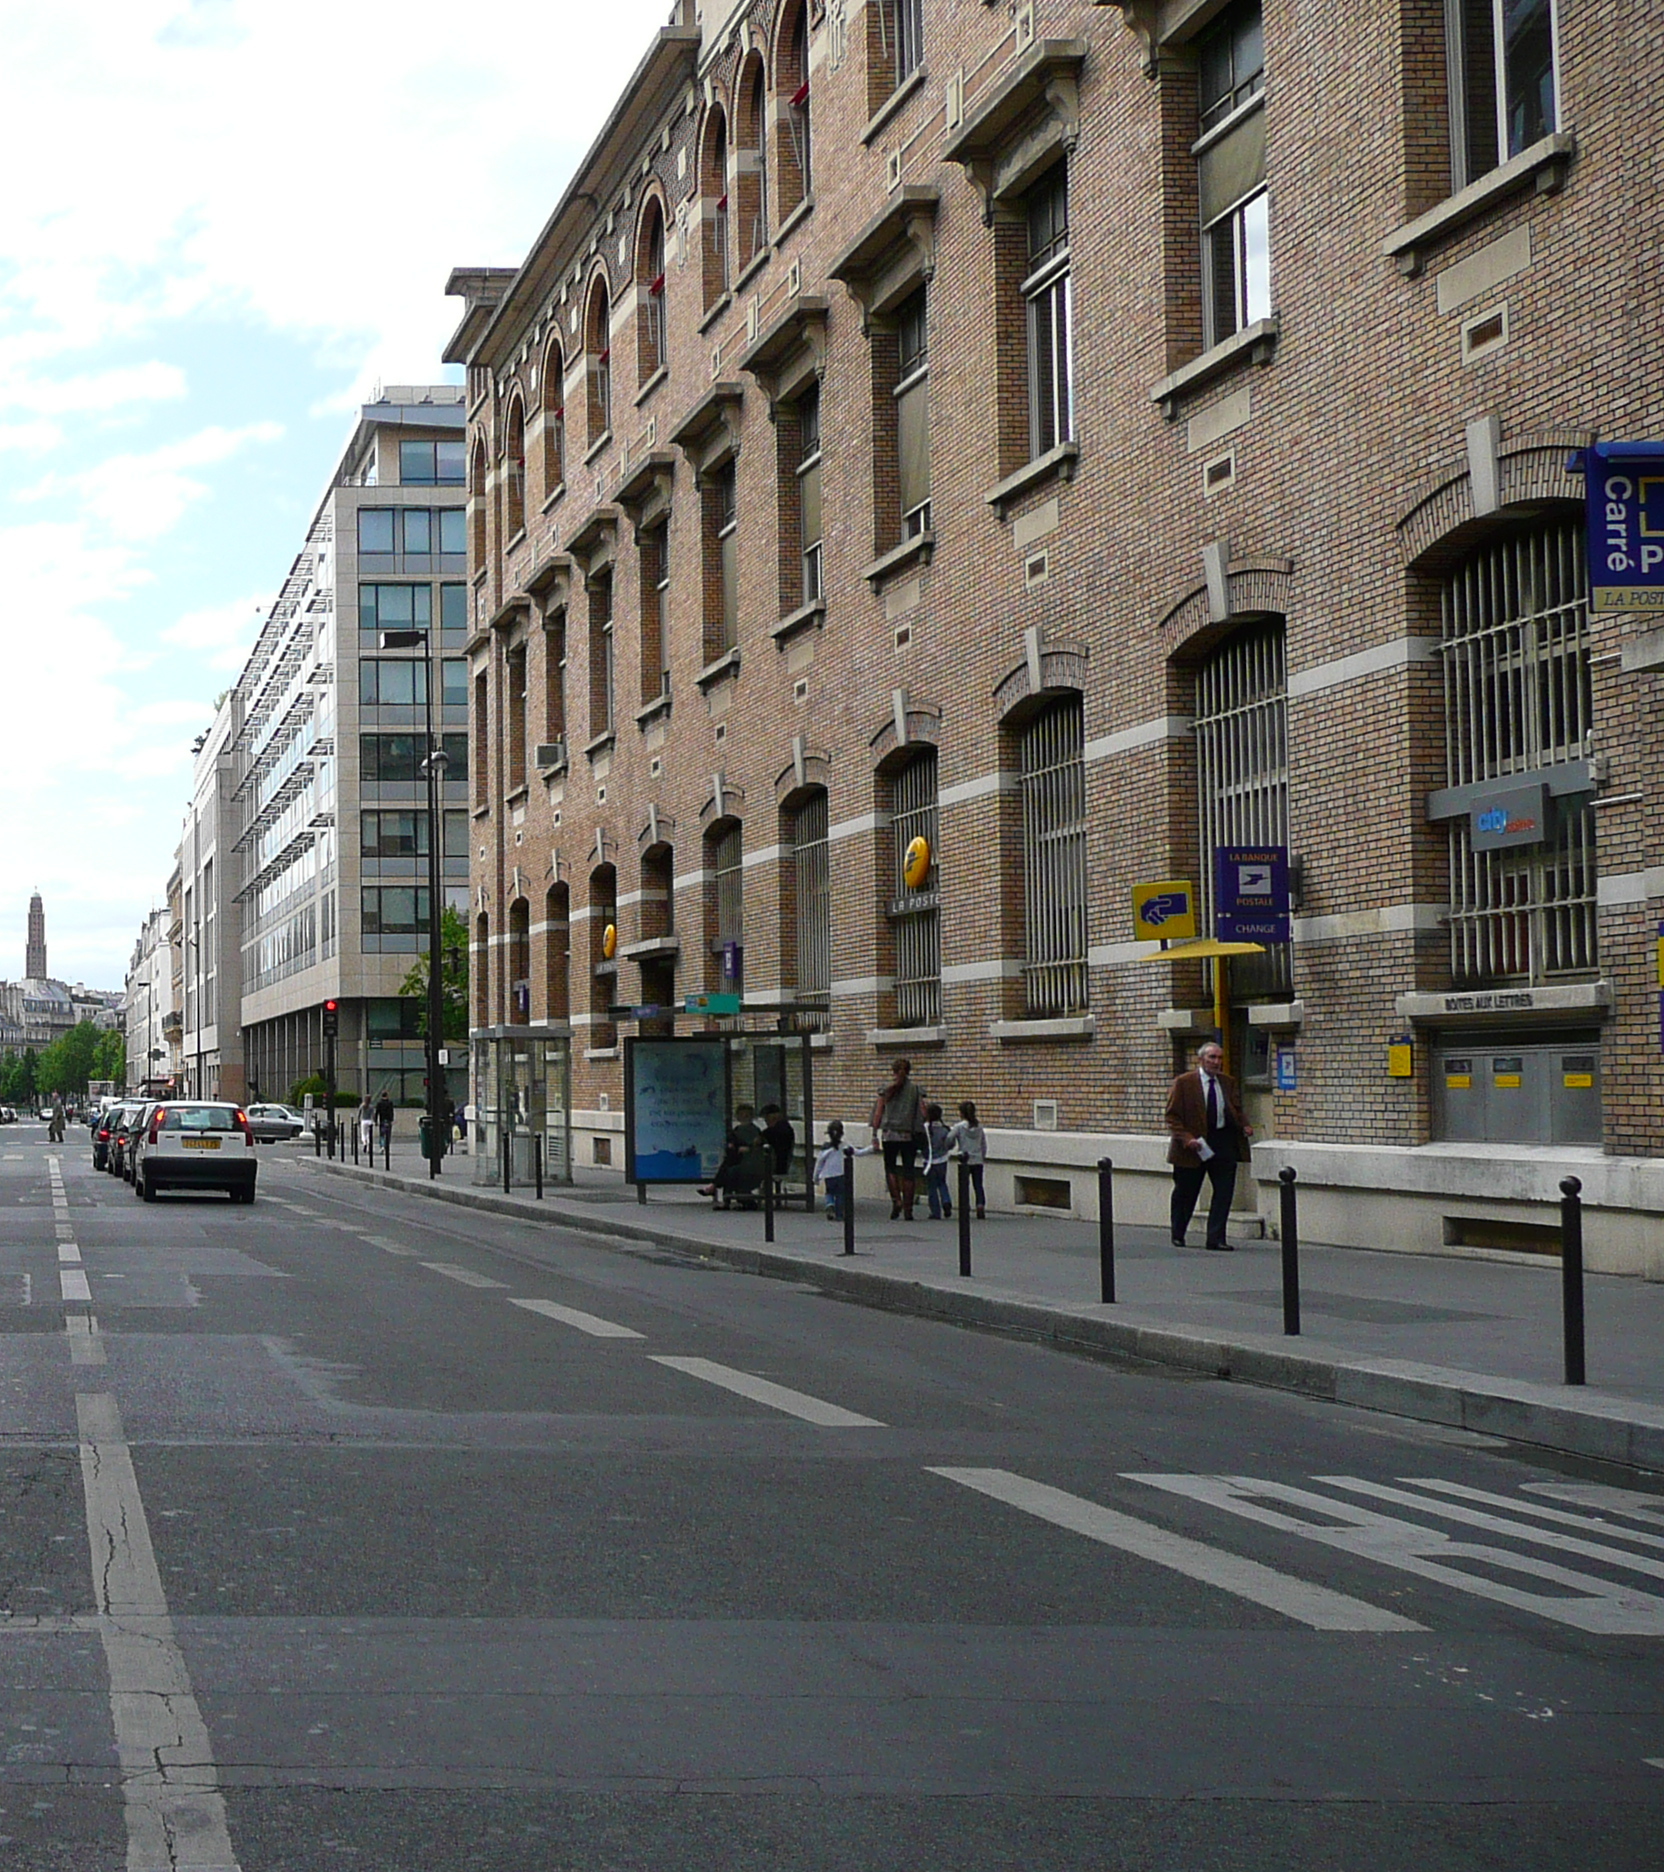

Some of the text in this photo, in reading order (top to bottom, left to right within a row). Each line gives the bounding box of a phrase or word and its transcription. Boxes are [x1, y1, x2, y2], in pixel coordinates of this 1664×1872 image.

[1604, 475, 1636, 572] Carré
[1603, 592, 1627, 606] LA
[1229, 853, 1278, 863] LA BANQUE
[892, 892, 944, 913] LA POSTE
[1236, 897, 1274, 906] POSTALE
[1235, 924, 1276, 934] CHANGE
[1476, 996, 1493, 1010] AUX
[1495, 993, 1533, 1009] LETTRES
